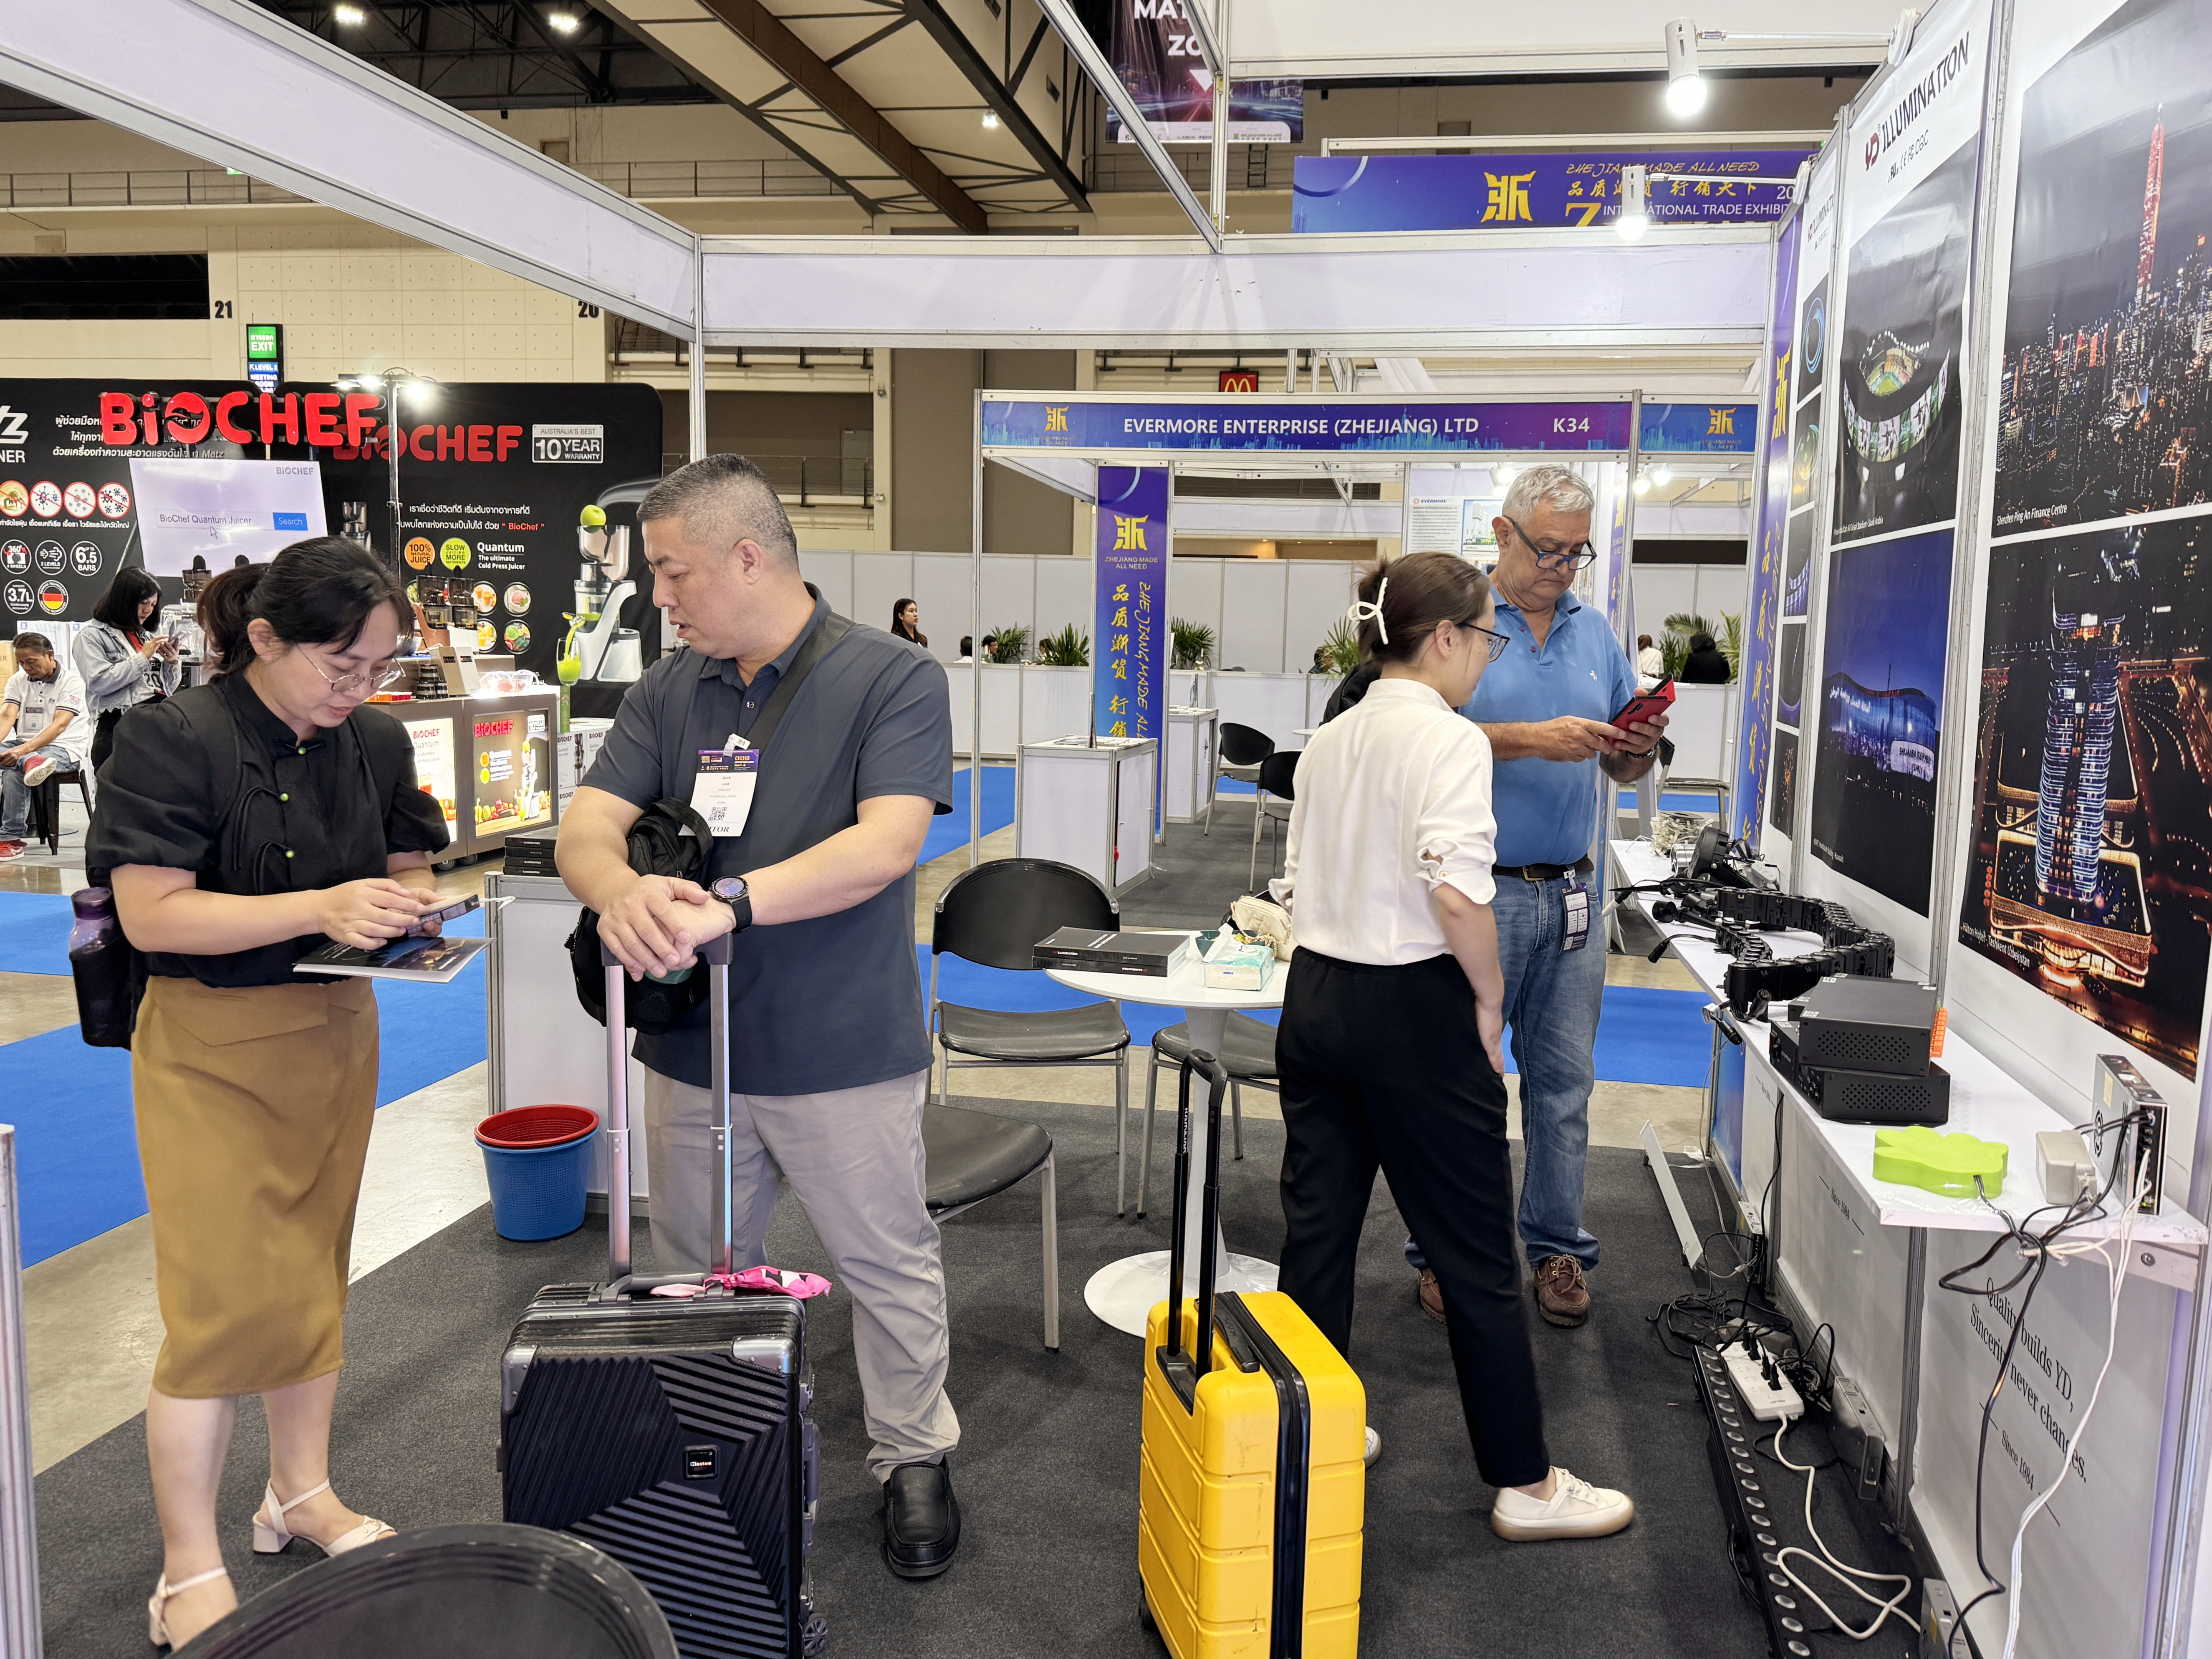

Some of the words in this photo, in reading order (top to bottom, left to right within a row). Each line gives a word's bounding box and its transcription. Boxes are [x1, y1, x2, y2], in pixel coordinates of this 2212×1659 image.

[1882, 30, 1969, 154] ILLUMINATION
[1717, 162, 1760, 172] NEED
[1702, 204, 1742, 215] TRADE
[215, 300, 232, 318] 21
[578, 300, 599, 318] 20
[251, 341, 274, 351] EXIT
[1124, 418, 1217, 433] EVERMORE
[1224, 419, 1328, 434] ENTERPRISE
[1334, 419, 1438, 436] (ZHEJIANG)
[1444, 418, 1479, 433] LTD
[1553, 418, 1590, 433] K34
[535, 439, 561, 460] 10
[562, 439, 600, 452] YEAR
[160, 514, 189, 523] BioChef
[192, 515, 226, 525] Quantum
[229, 516, 252, 525] Juicer
[2014, 511, 2024, 524] Ping
[2024, 510, 2030, 520] An
[2031, 508, 2050, 519] Finance
[2051, 503, 2067, 516] Centre
[76, 546, 97, 564] 6.5
[477, 542, 525, 554] Quantum
[8, 588, 33, 602] 3.7L
[1137, 662, 1149, 710] MADE
[1988, 935, 2007, 954] Tashkent
[2007, 945, 2030, 968] Uzbekistan
[2020, 1319, 2052, 1378] builds
[2055, 1359, 2074, 1413] YD,
[2010, 1361, 2038, 1413] never
[2001, 1430, 2018, 1468] Since
[2018, 1457, 2034, 1490] 1984
